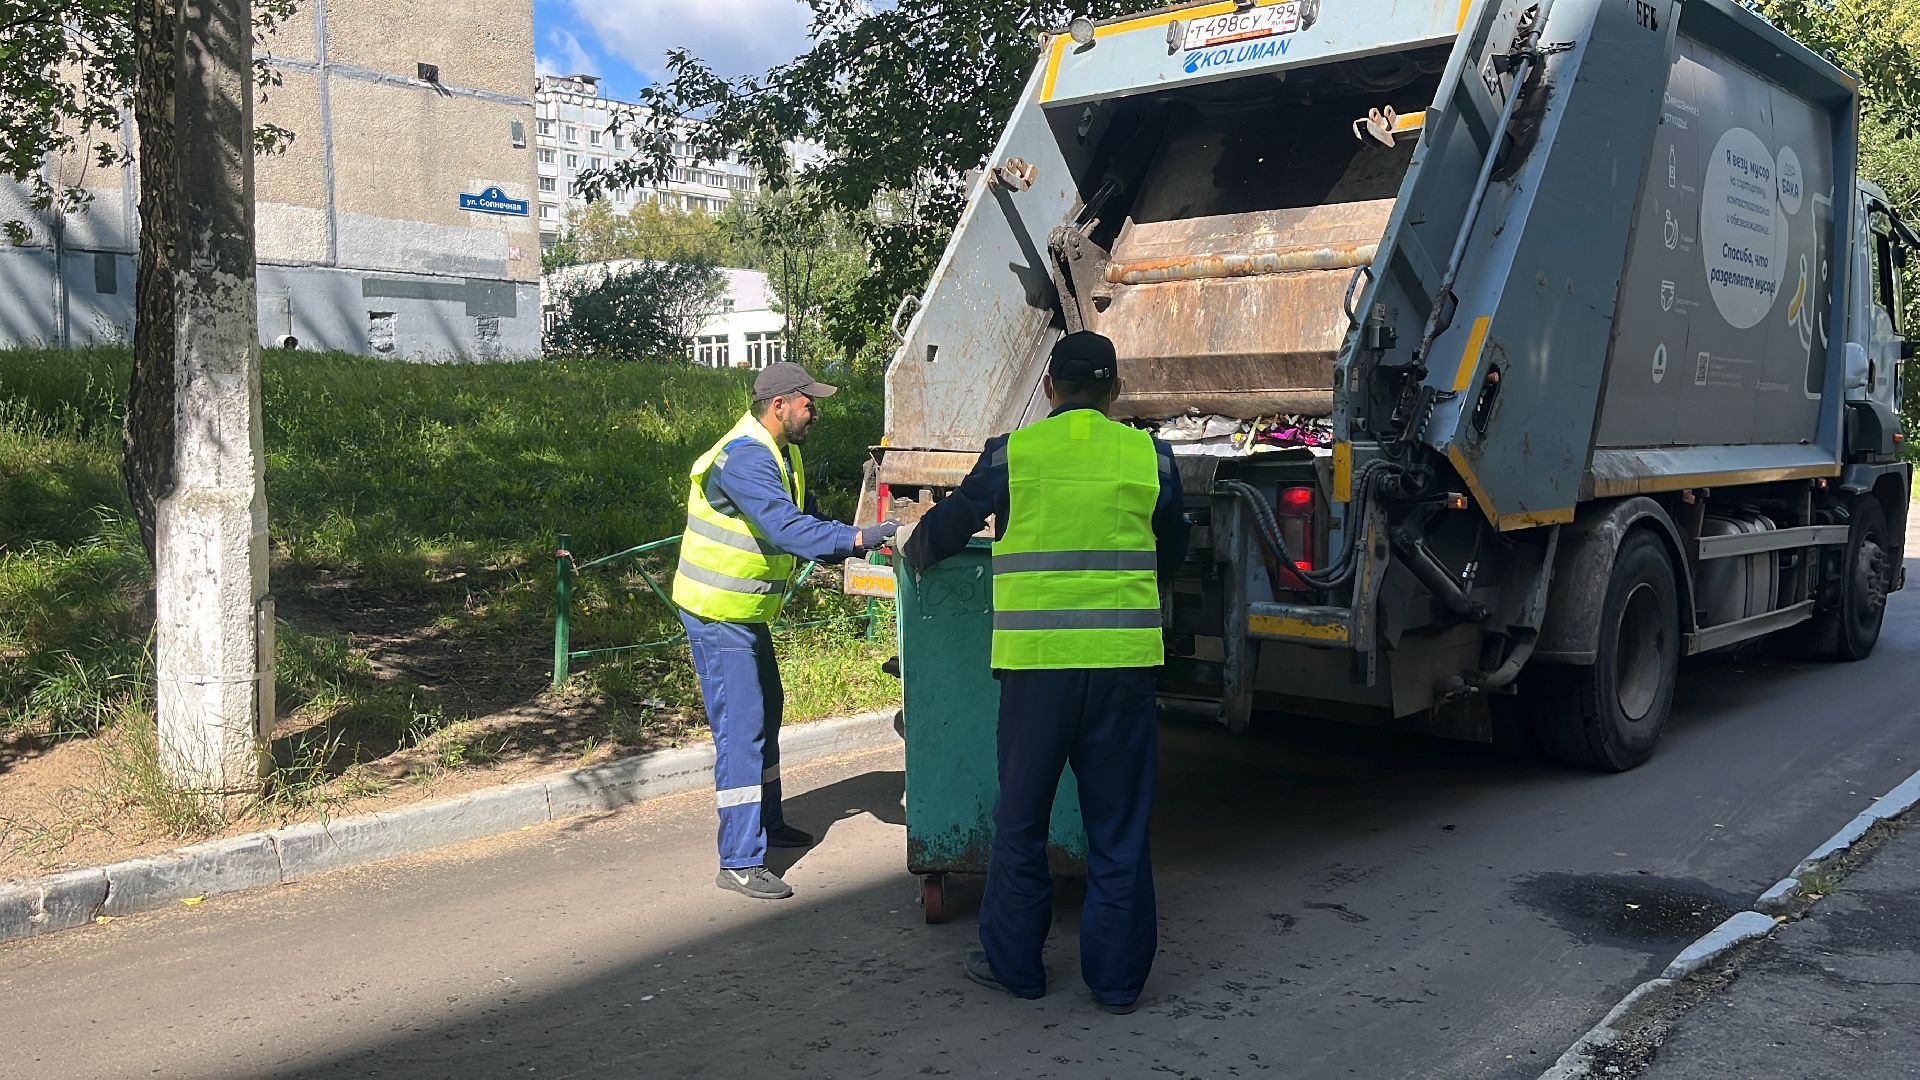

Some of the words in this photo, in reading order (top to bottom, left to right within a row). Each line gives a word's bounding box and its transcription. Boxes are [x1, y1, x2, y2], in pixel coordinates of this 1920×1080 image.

[1267, 4, 1295, 21] 799
[1200, 38, 1292, 68] KOLUMAN
[1726, 149, 1732, 165] Я
[1732, 154, 1749, 175] везу
[1749, 161, 1770, 182] мусор
[491, 189, 498, 199] 5
[1782, 178, 1799, 200] БАКА
[479, 198, 522, 211] Солнечная
[1722, 242, 1754, 267] Спасибо,
[1754, 253, 1769, 268] что
[1710, 268, 1754, 289] разделяете
